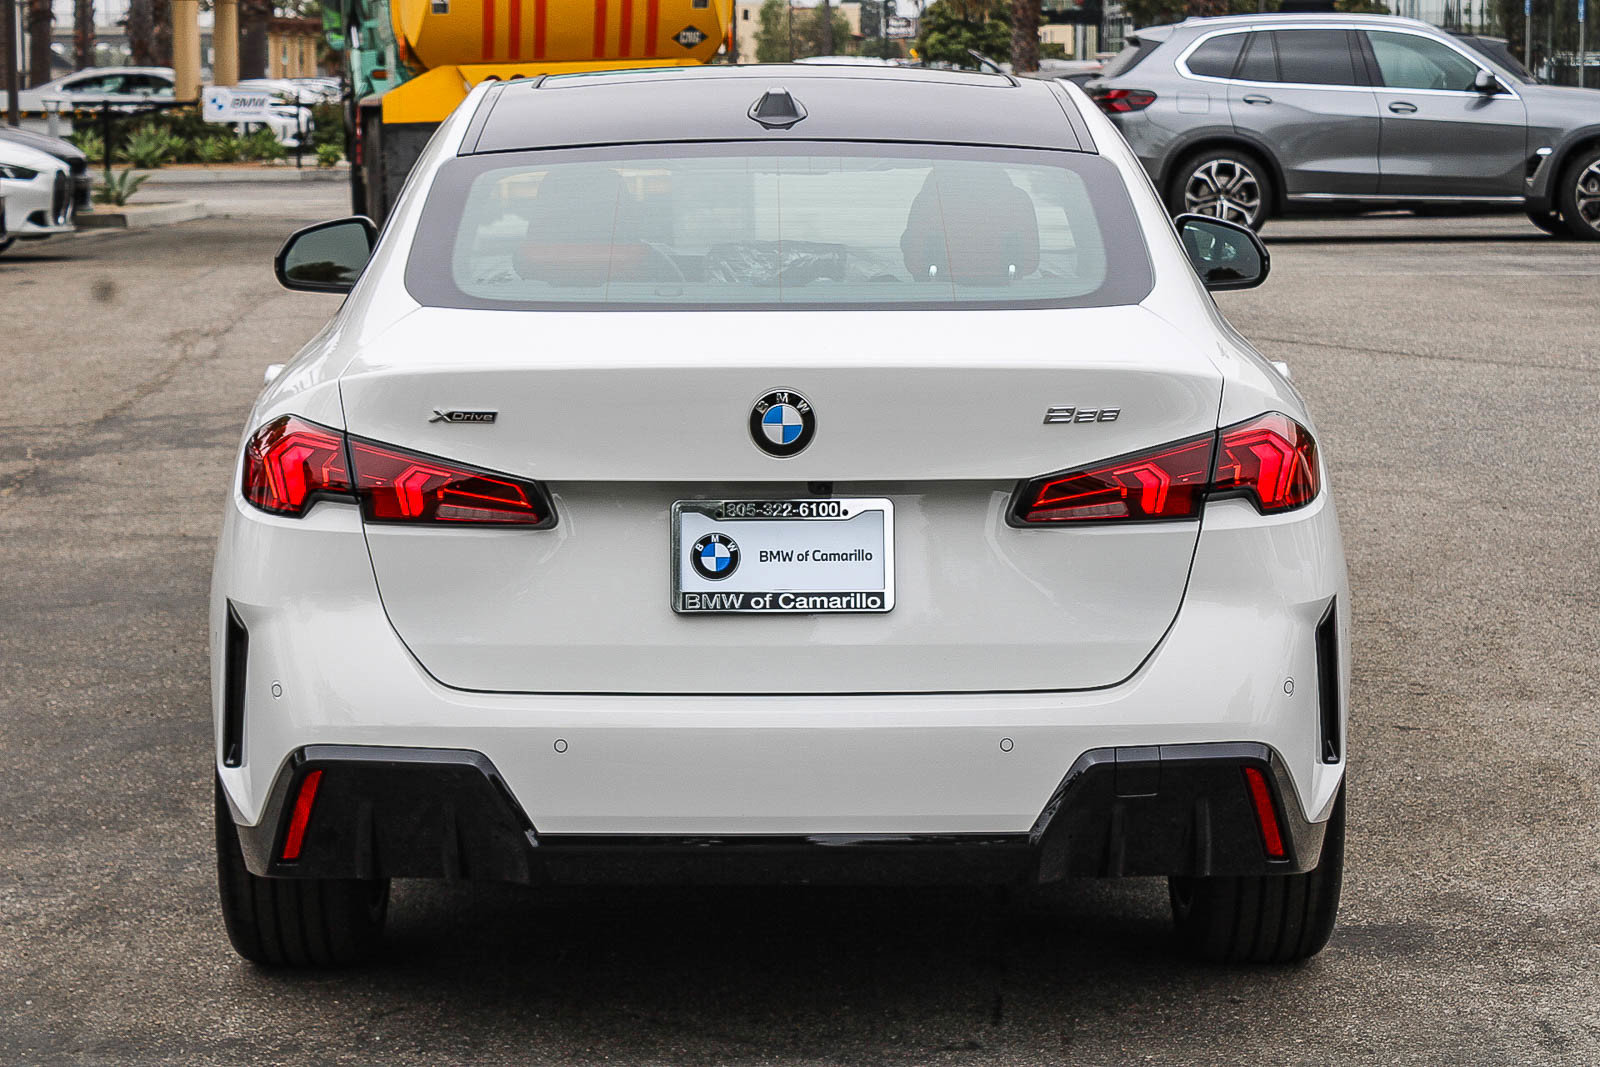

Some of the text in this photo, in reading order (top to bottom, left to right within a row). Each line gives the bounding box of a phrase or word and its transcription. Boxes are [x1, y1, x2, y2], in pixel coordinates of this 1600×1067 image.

[231, 97, 267, 108] BMW
[755, 392, 810, 415] BMW
[725, 502, 839, 517] 805-322-6100
[695, 534, 740, 552] BMW
[759, 549, 873, 562] BMW of Camarillo
[685, 593, 881, 609] BMW of Camarillo
